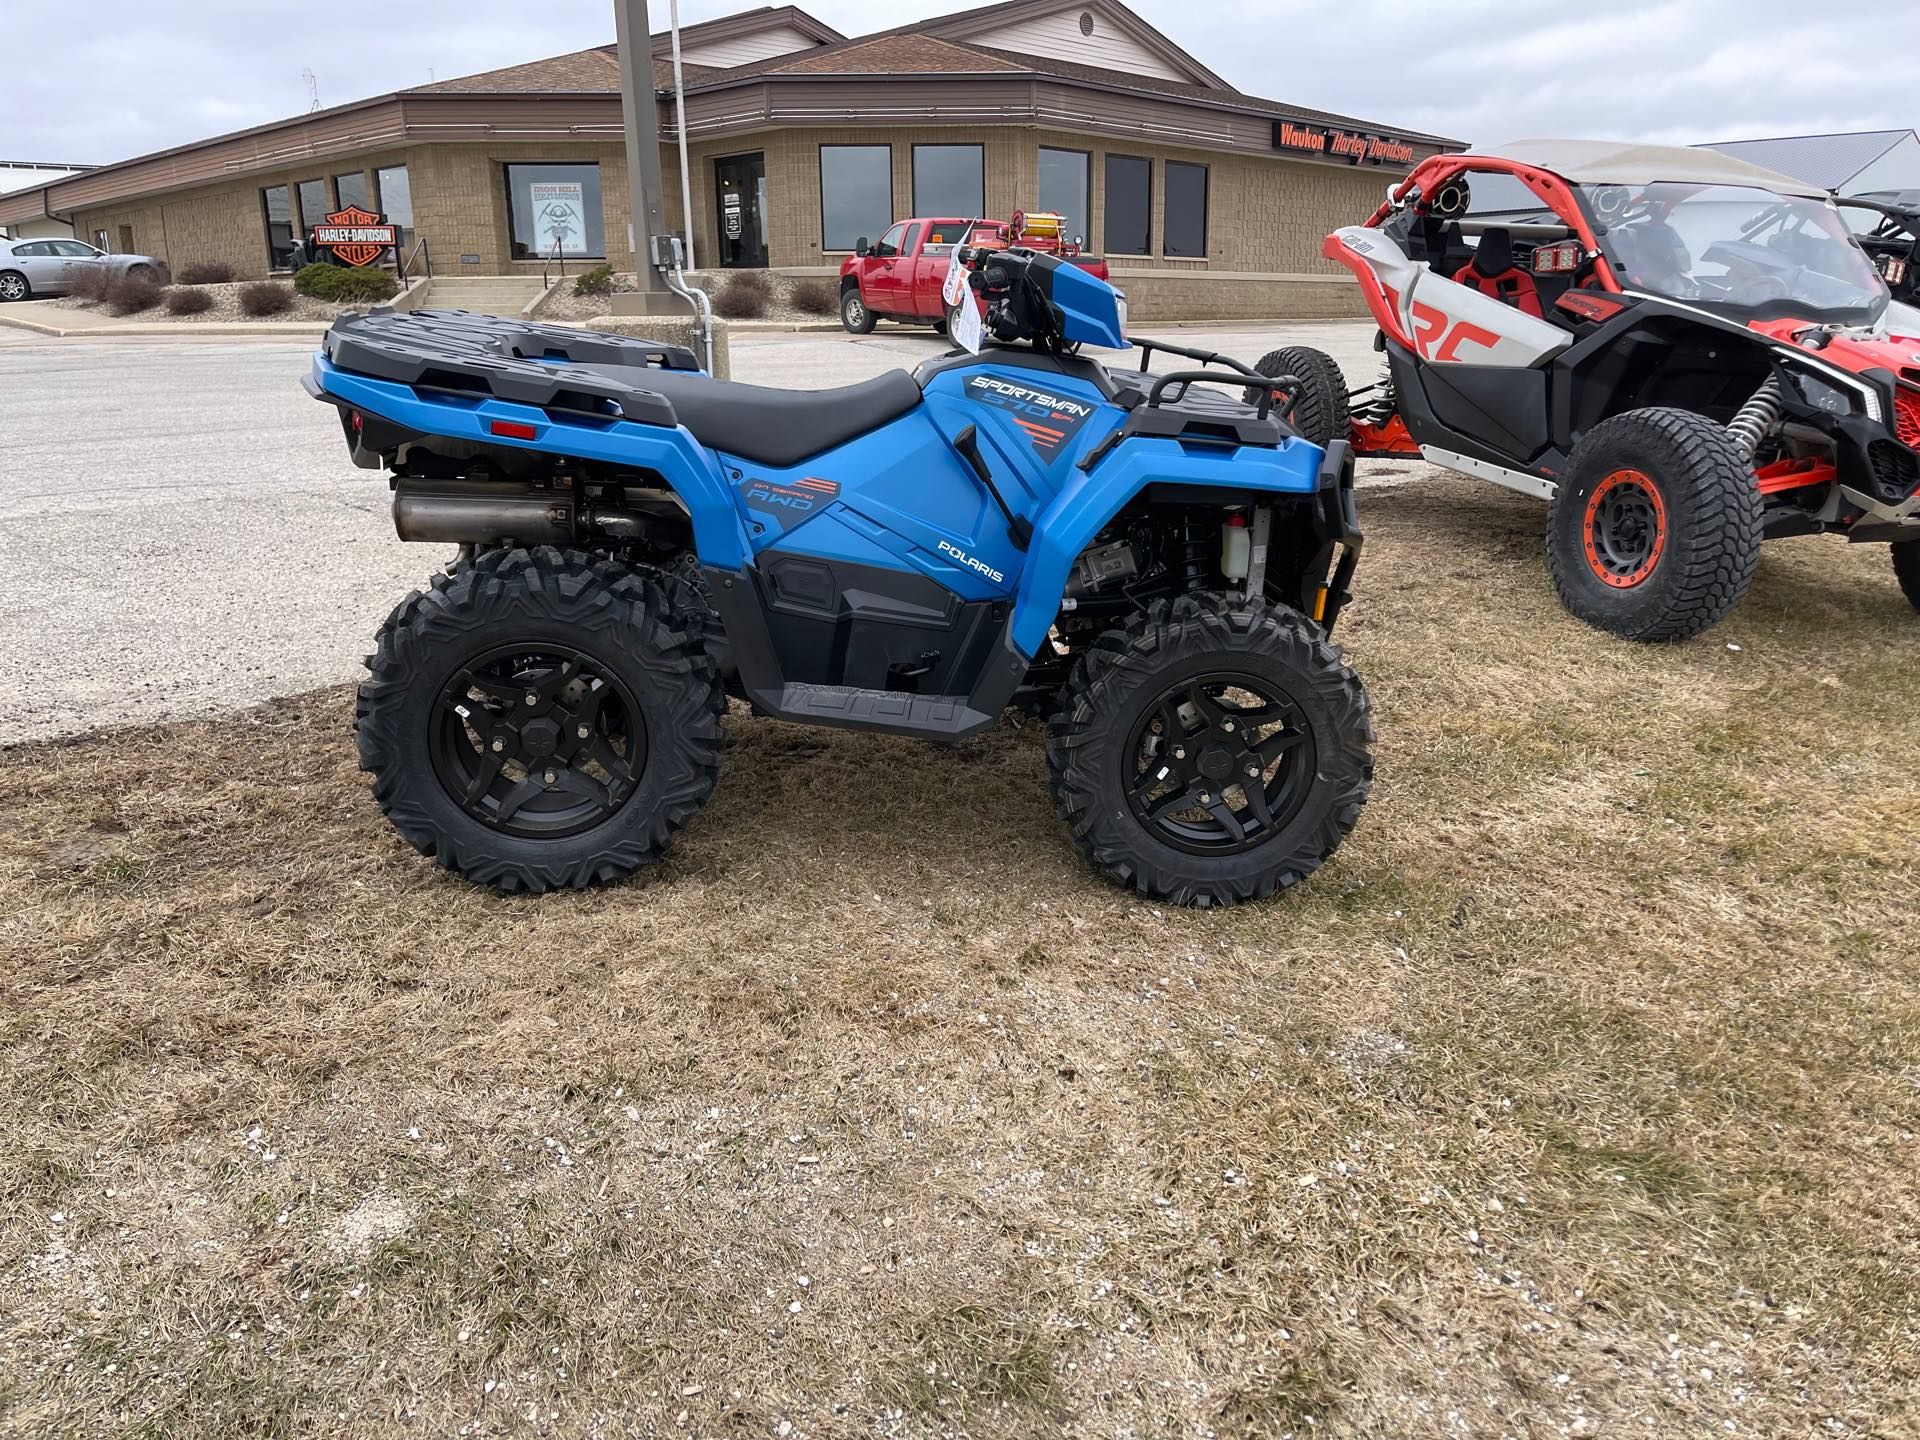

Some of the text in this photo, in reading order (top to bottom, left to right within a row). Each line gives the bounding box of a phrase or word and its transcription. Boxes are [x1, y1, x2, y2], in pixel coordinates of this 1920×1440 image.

[1281, 123, 1414, 164] Waukon Harley Davidson
[334, 210, 373, 225] MOTOR
[318, 228, 392, 242] HARLEY-DAVIDSON
[338, 245, 376, 262] CYCLES
[971, 376, 1091, 417] SPORTSMAN
[982, 392, 1050, 418] 570
[746, 488, 813, 510] AWD
[938, 540, 1004, 583] POLARIS
